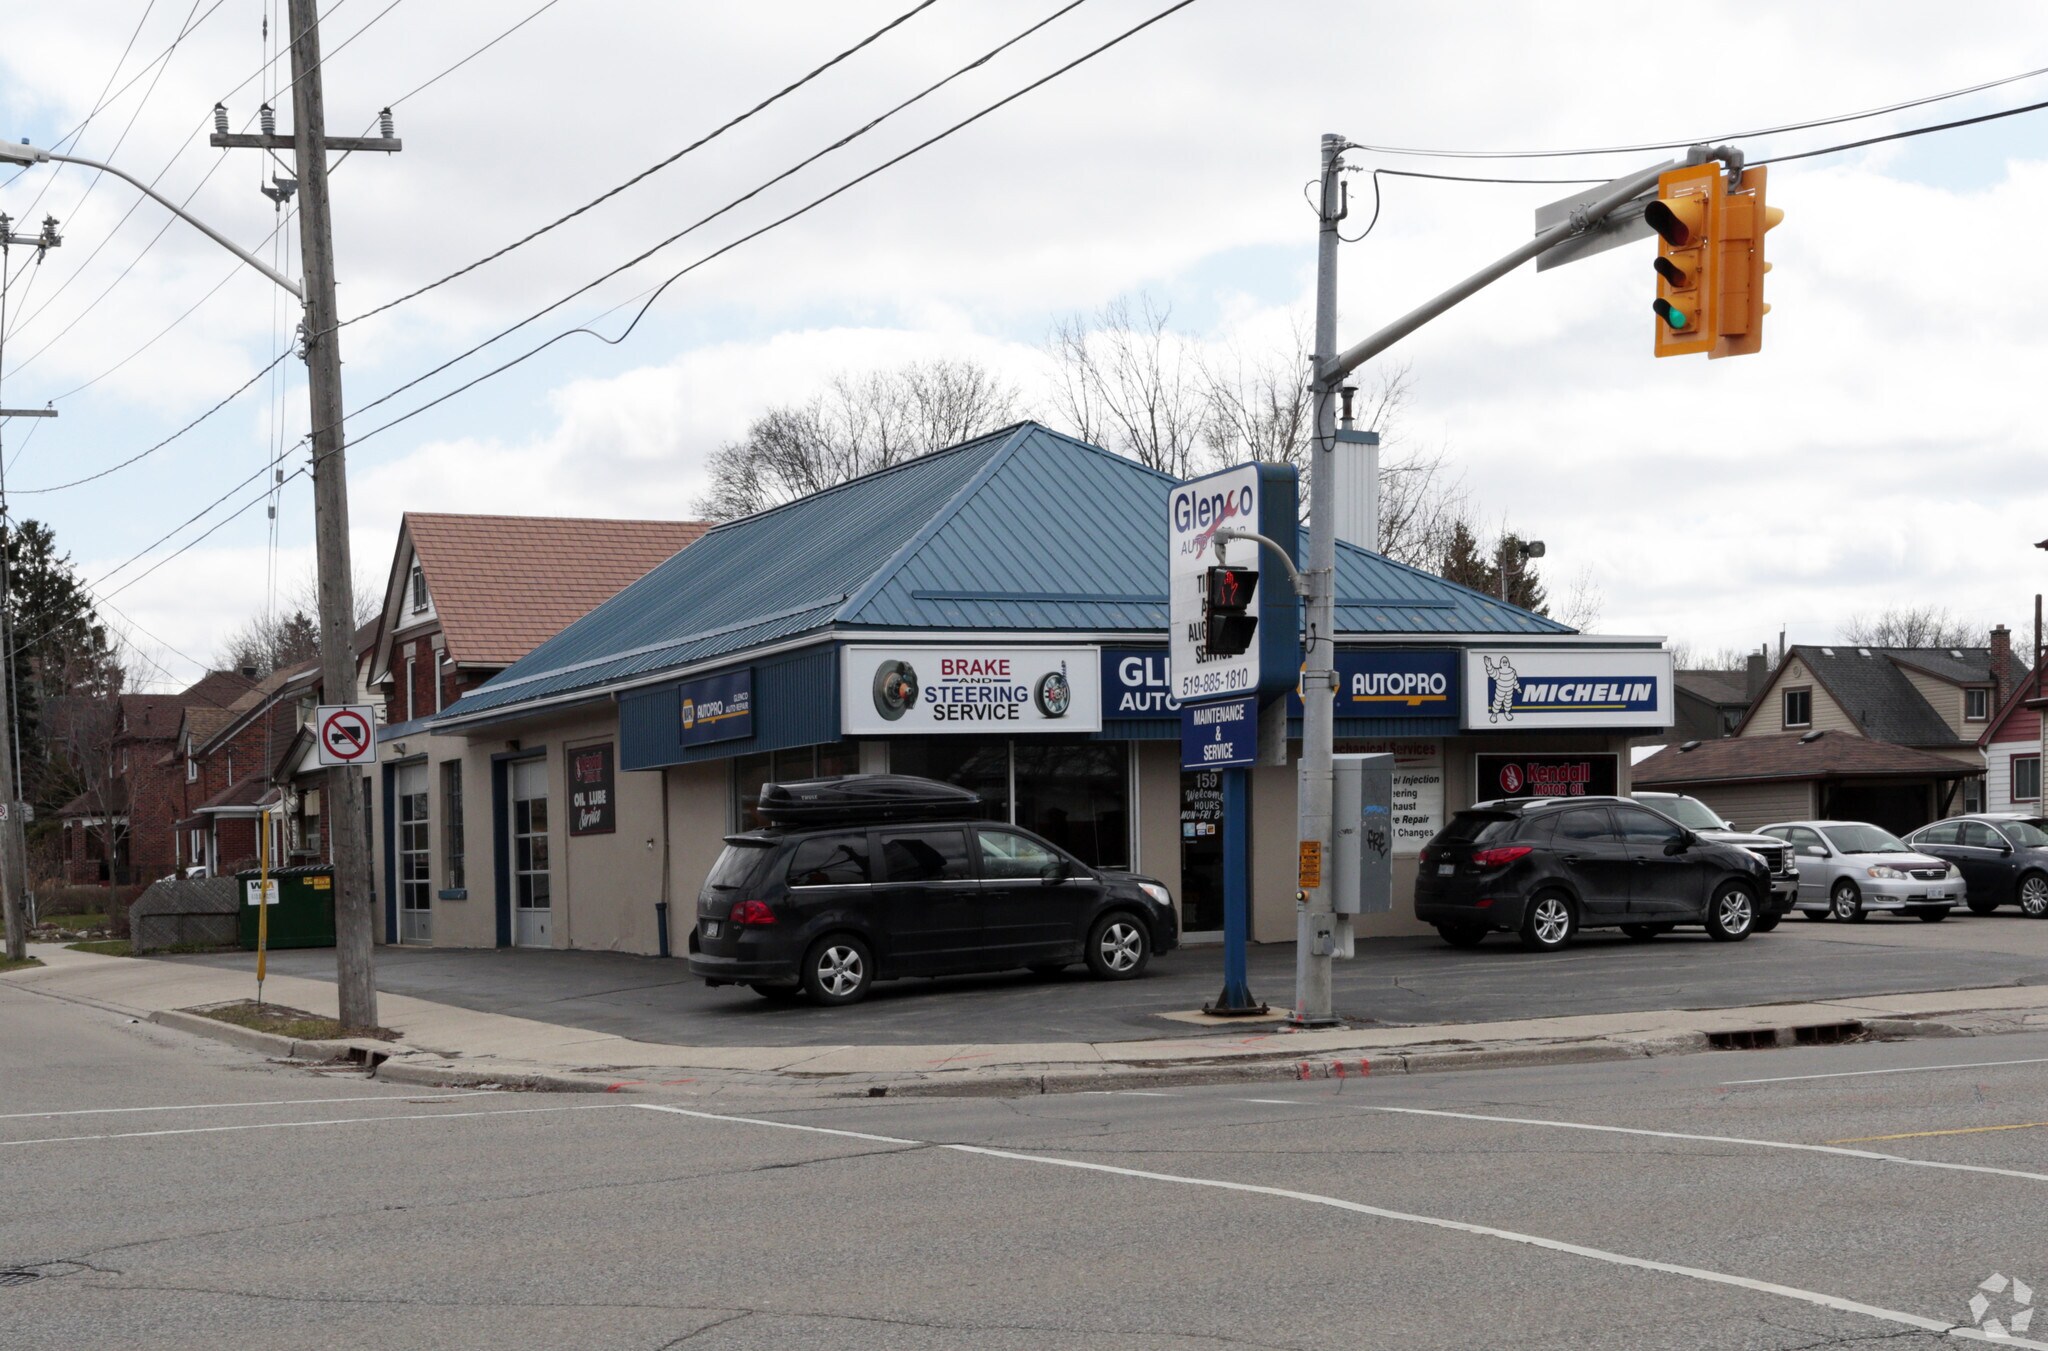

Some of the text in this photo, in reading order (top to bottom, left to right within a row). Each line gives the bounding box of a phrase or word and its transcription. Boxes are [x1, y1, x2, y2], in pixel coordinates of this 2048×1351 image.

[941, 659, 1010, 676] BRAKE
[1183, 668, 1248, 695] 519-885-1810
[1352, 673, 1446, 695] AUTOPRO
[925, 686, 1028, 703] STEERING
[1118, 691, 1182, 711] AUTO
[1521, 683, 1652, 702] MICHELIN
[697, 700, 723, 719] AUTOPRO
[933, 703, 1020, 721] SERVICE
[1193, 704, 1245, 726] MAINTENANCE
[1215, 725, 1222, 741] &
[1203, 743, 1233, 761] SERVICE
[1333, 741, 1436, 756] echanical Services
[1196, 773, 1218, 788] 159
[1403, 774, 1440, 786] Injection
[1527, 762, 1590, 783] Kendall
[1533, 782, 1586, 796] MOTOR OIL
[574, 789, 607, 808] OIL LUBE
[1194, 800, 1220, 810] HOURS
[579, 806, 601, 831] Service
[1402, 814, 1430, 825] Repair
[1398, 828, 1434, 838] Changes
